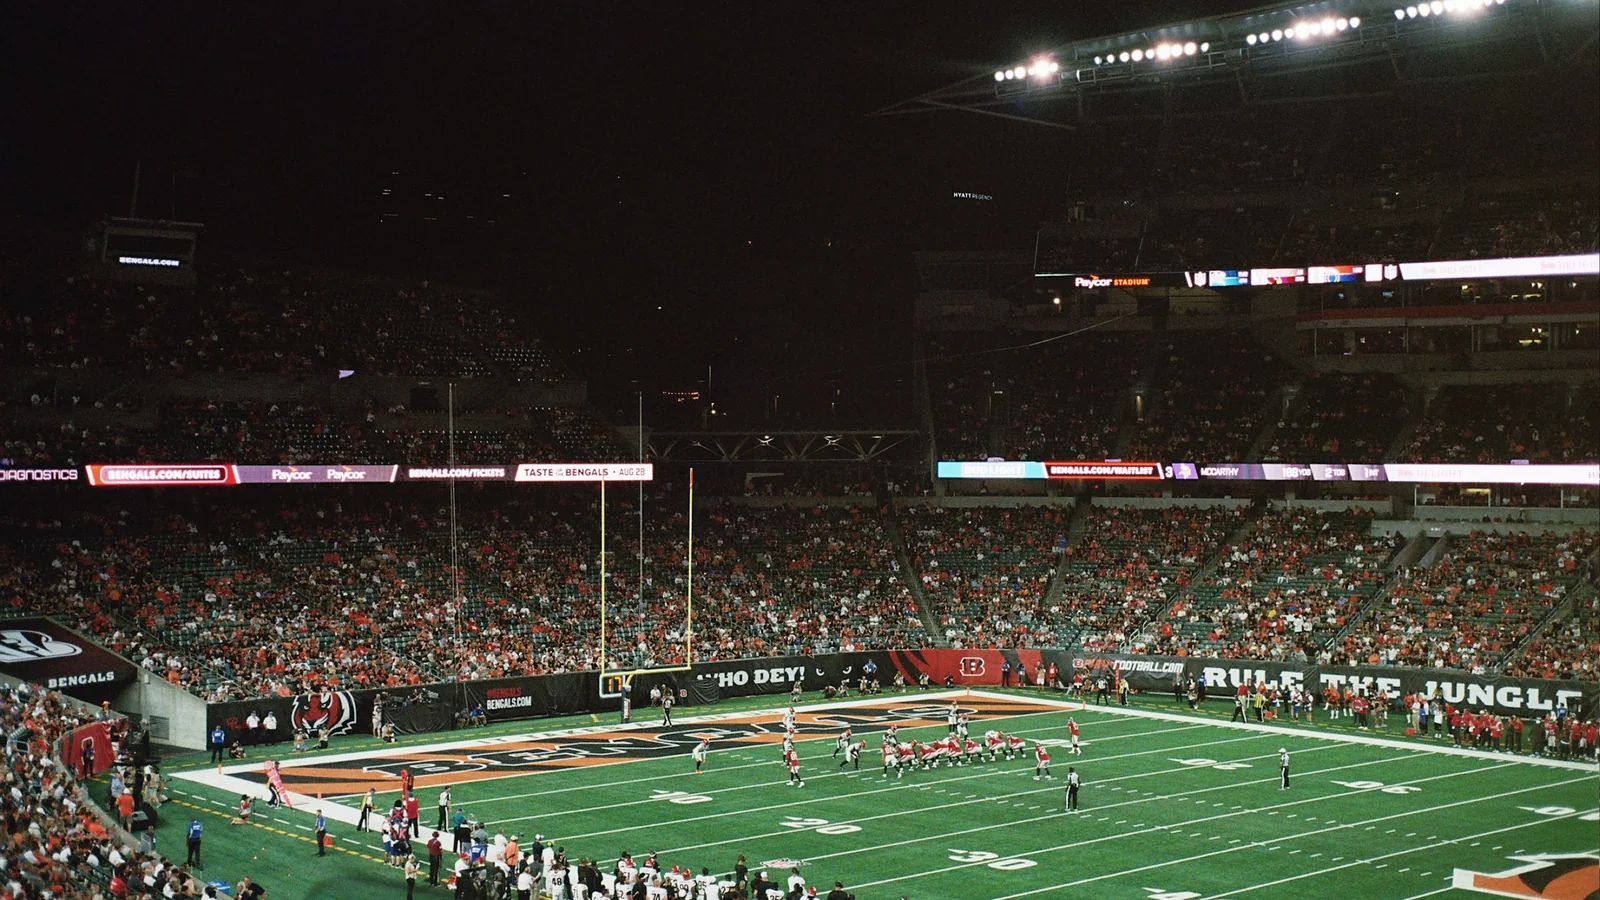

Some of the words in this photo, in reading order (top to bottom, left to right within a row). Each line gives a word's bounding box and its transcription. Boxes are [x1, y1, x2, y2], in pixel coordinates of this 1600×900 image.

[119, 257, 180, 267] BENGALS.COM
[1075, 277, 1113, 290] Paycor
[1114, 278, 1149, 286] STADIUM
[107, 469, 220, 481] BENGALS.COM/SUITES
[272, 469, 313, 483] Paycor
[327, 469, 366, 483] Paycor
[408, 468, 506, 478] BENGALS.COM/TICKETS
[524, 468, 554, 477] TASTE
[565, 468, 609, 477] BENGALS
[618, 468, 635, 477] AUG
[636, 467, 646, 476] 28
[1051, 465, 1154, 476] BENGALS.COM/WAITLIST
[1165, 465, 1173, 477] 3
[1201, 468, 1239, 476] MCCARTHY
[1325, 467, 1333, 477] 2
[48, 671, 115, 688] BENGALS
[697, 670, 748, 688] HO
[753, 667, 806, 684] DEY!
[1203, 667, 1305, 690] RULE
[1319, 674, 1402, 698] THE
[608, 676, 622, 693] 17
[487, 696, 532, 710] BENGALS.COM
[649, 791, 713, 804] 10
[779, 818, 862, 834] 20
[949, 851, 1038, 870] 30
[552, 877, 562, 886] 48
